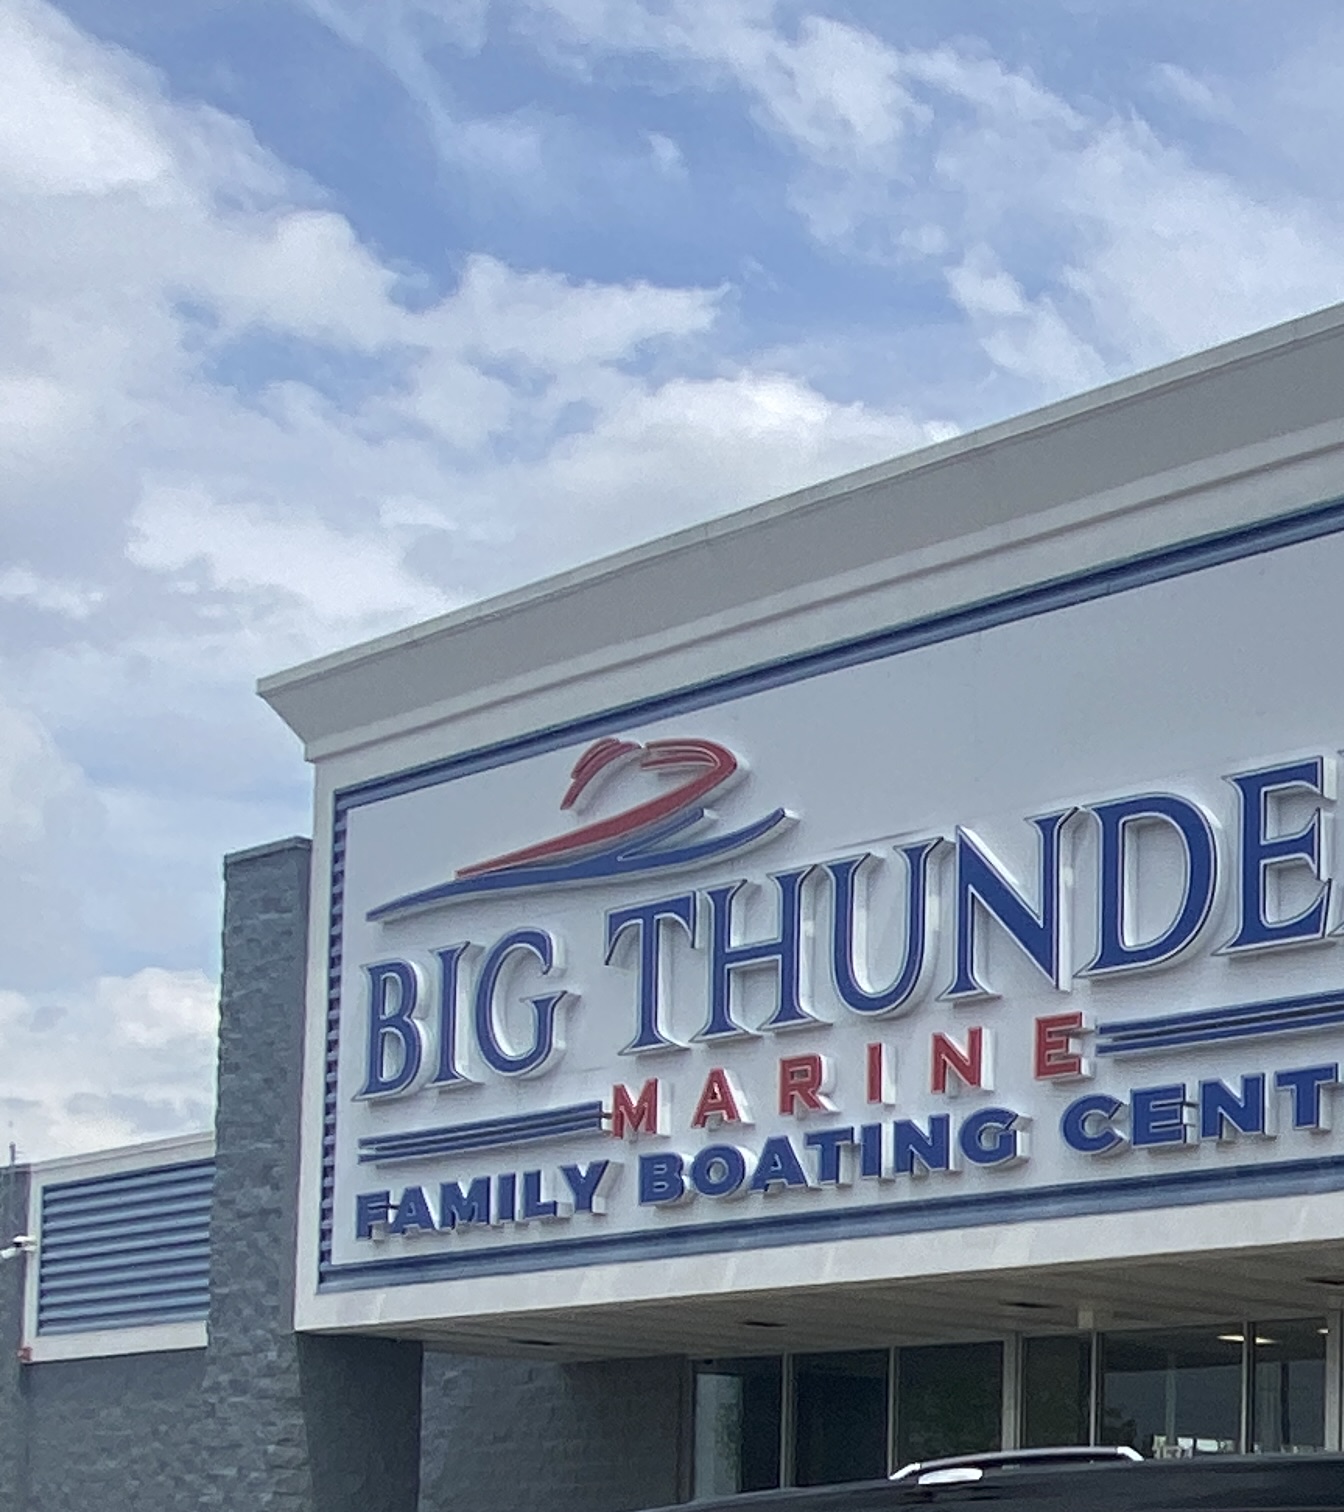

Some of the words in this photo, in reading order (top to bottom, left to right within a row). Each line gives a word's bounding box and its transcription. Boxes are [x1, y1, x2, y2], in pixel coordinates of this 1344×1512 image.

[352, 926, 571, 1101] BIG
[612, 1010, 1084, 1139] MARINE
[355, 1159, 609, 1241] FAMILY
[637, 1106, 1021, 1207] BOATING
